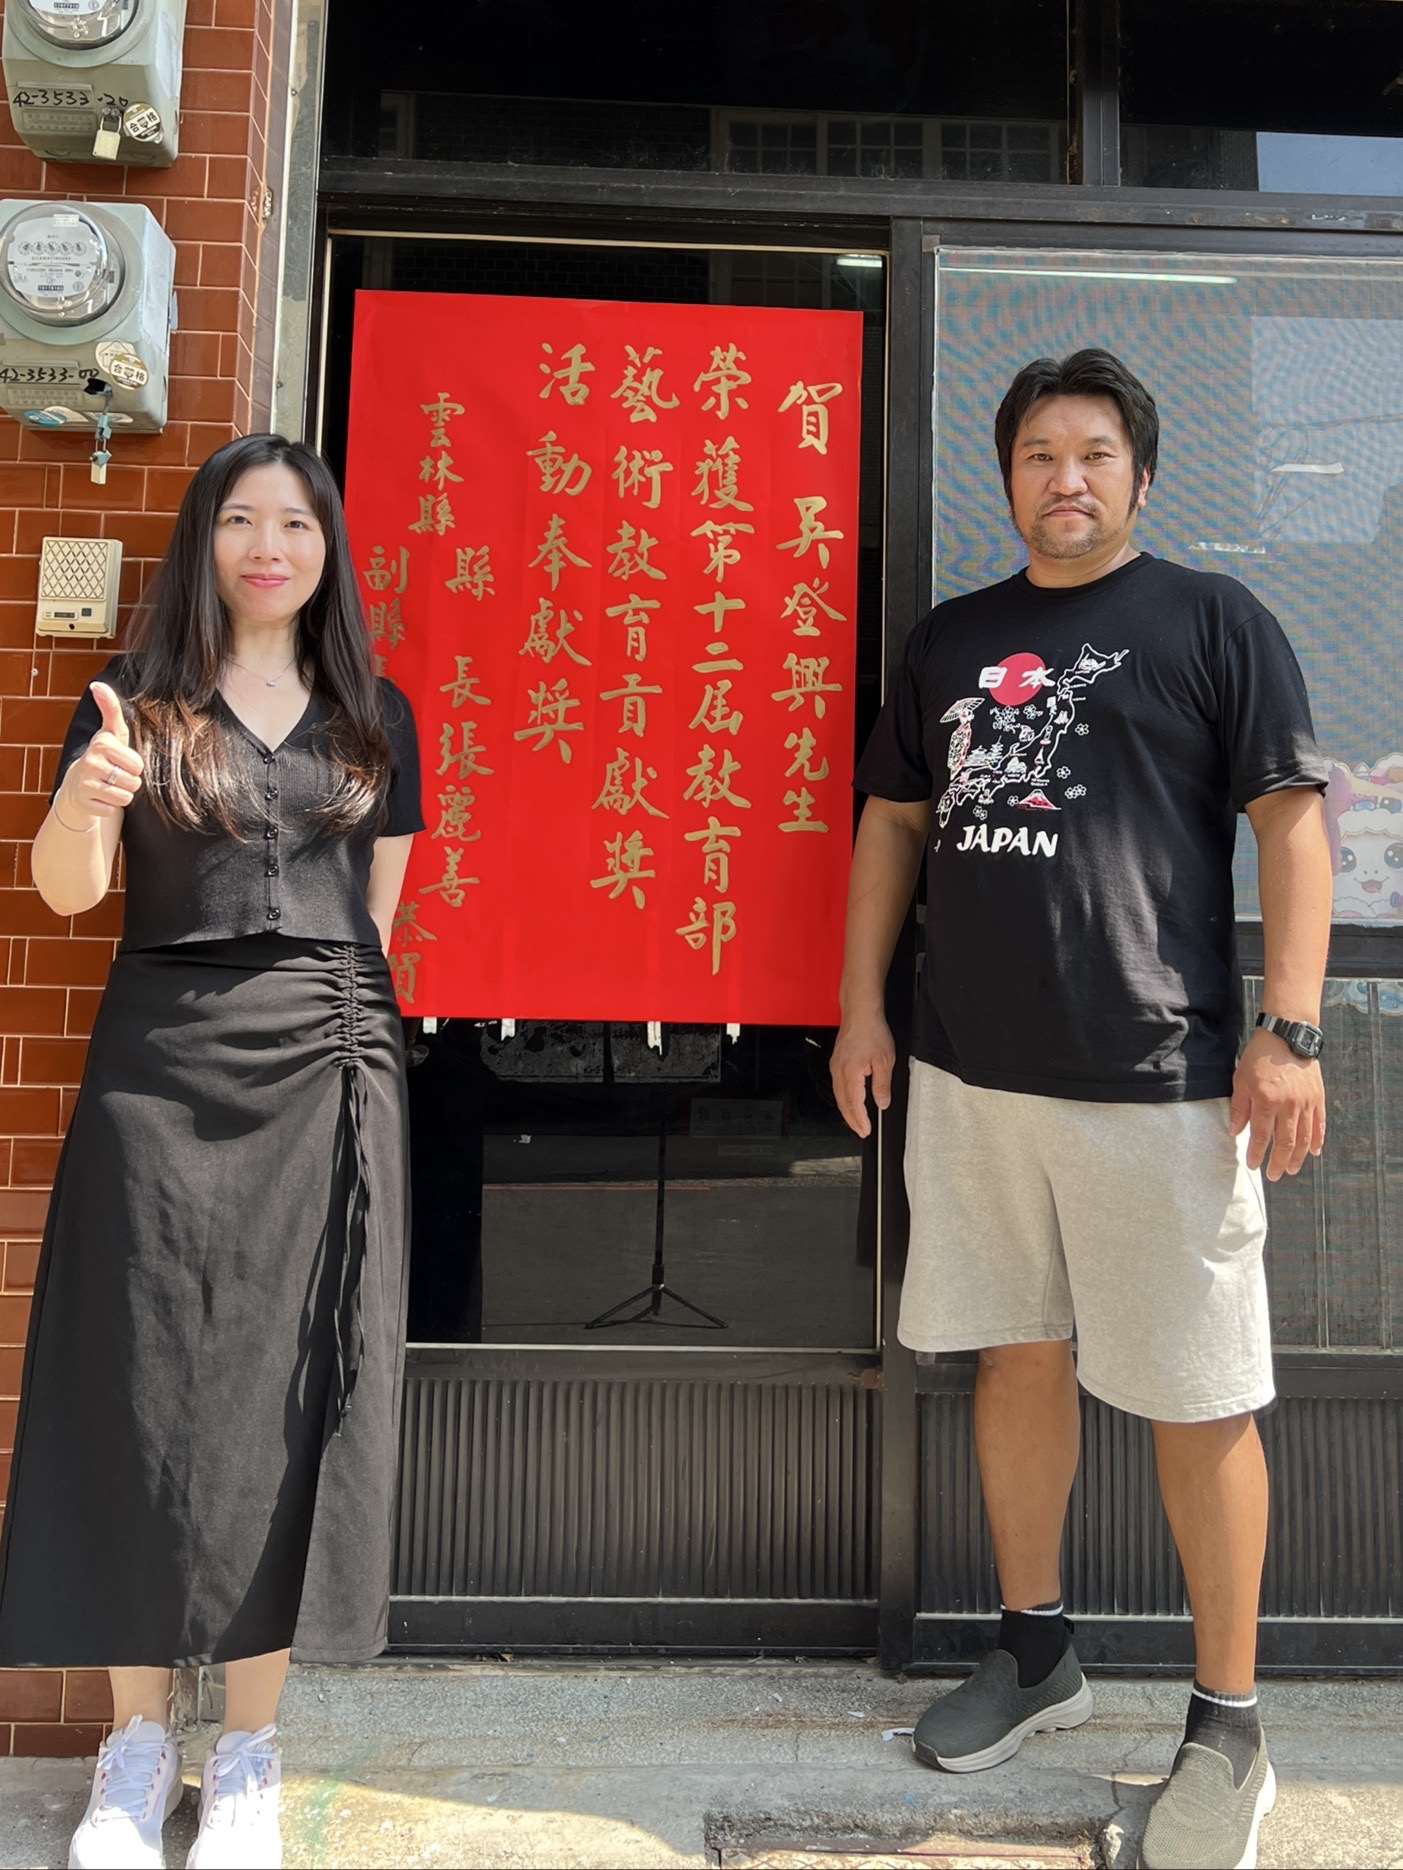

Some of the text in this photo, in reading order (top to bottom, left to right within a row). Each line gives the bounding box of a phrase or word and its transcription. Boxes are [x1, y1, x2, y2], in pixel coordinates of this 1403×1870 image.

[408, 391, 465, 536] 雲林縣
[771, 380, 847, 833] 賀 吳登興先生
[978, 665, 1056, 690] 日本
[420, 545, 495, 908] 縣長張麗善
[956, 823, 1059, 858] JAPAN
